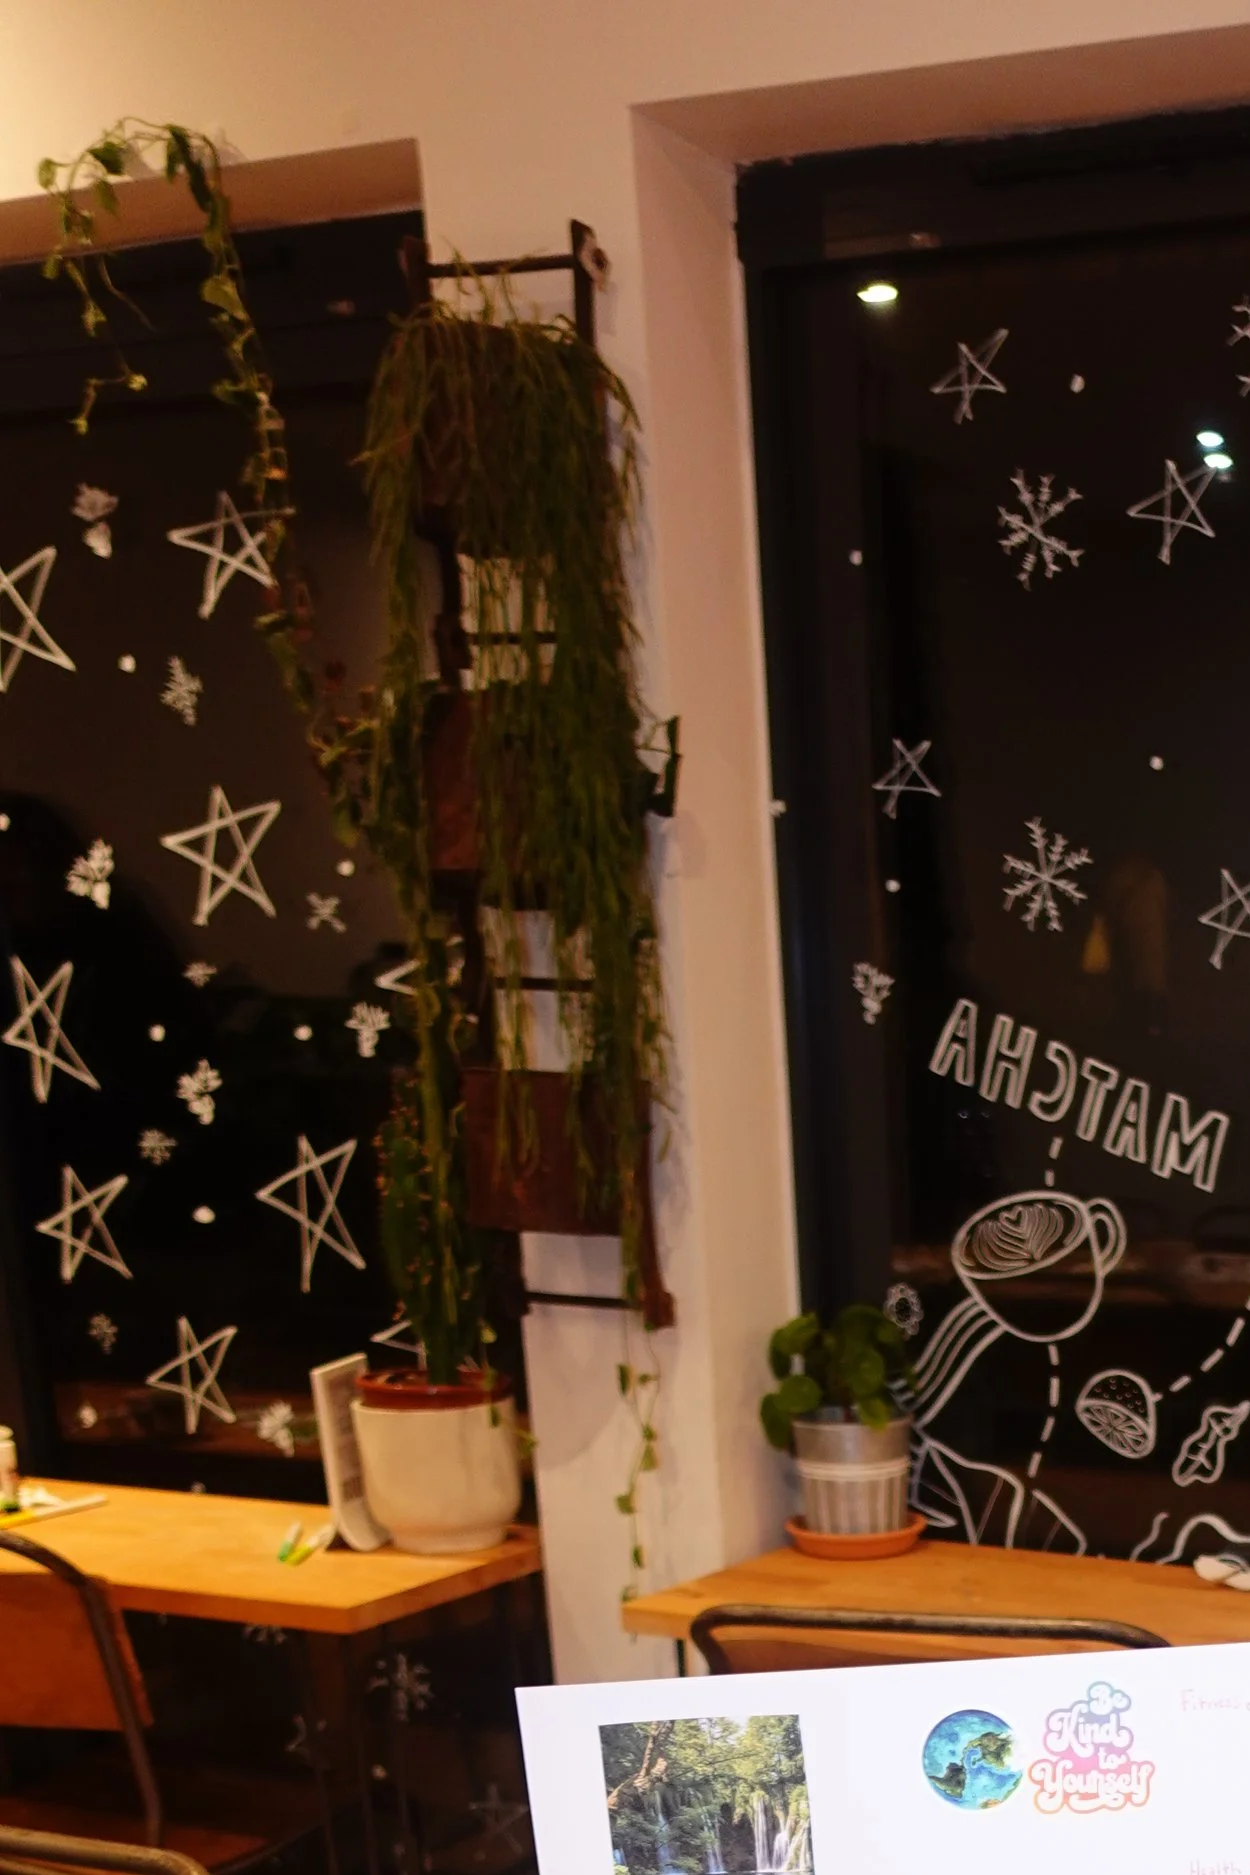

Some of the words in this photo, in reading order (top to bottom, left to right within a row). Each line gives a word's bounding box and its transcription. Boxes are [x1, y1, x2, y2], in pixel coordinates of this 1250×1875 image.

[1088, 1682, 1131, 1713] Be
[1180, 1688, 1241, 1713] Fitness
[1046, 1703, 1132, 1758] Kind
[1100, 1747, 1128, 1770] to
[1030, 1759, 1154, 1812] Yourself
